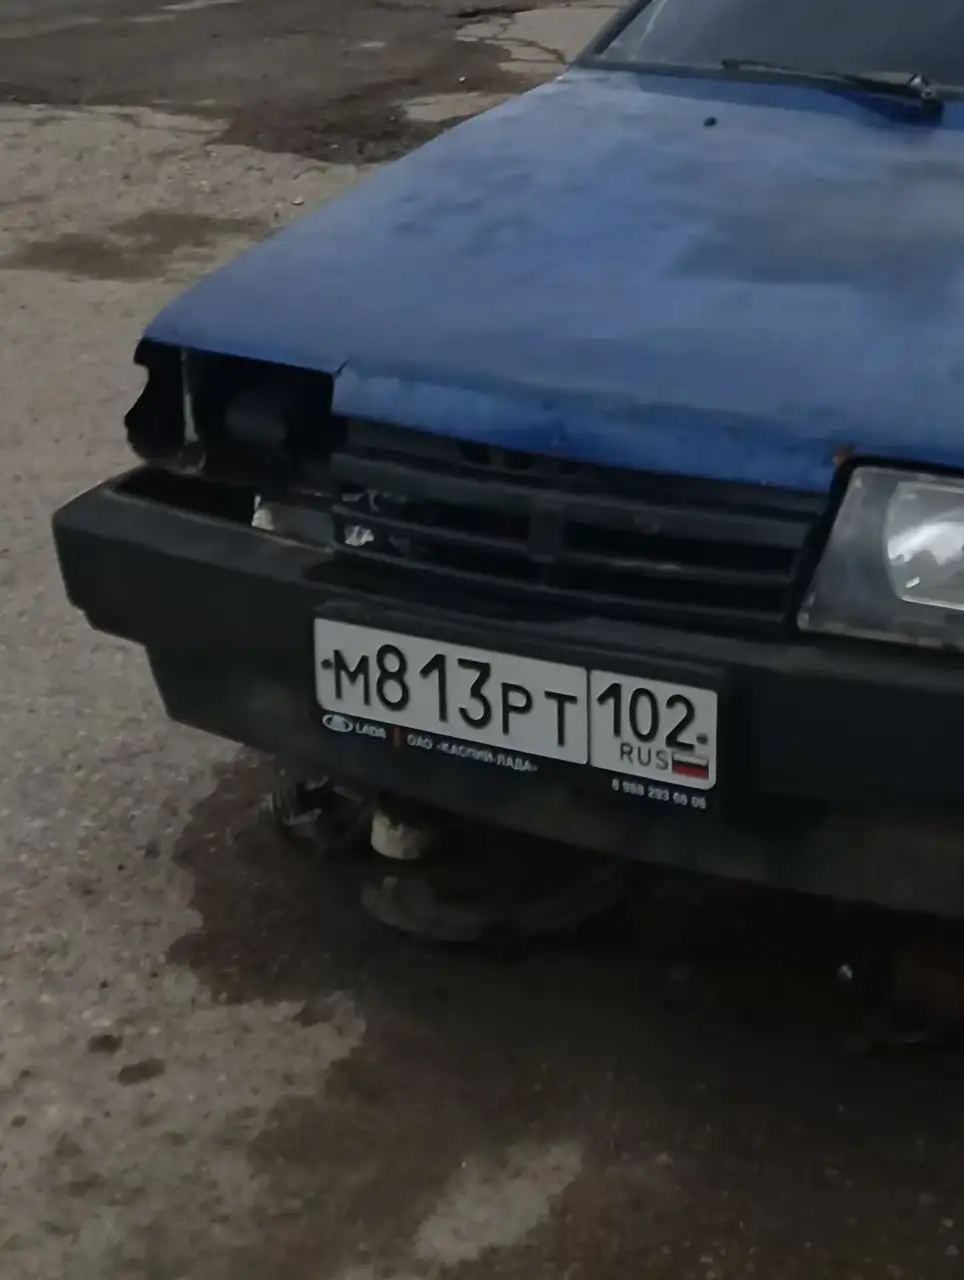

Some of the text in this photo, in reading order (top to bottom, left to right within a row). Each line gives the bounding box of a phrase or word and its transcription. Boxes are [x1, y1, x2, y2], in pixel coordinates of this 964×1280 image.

[332, 644, 578, 746] М813РТ
[597, 682, 696, 752] 102
[620, 742, 669, 771] RUS
